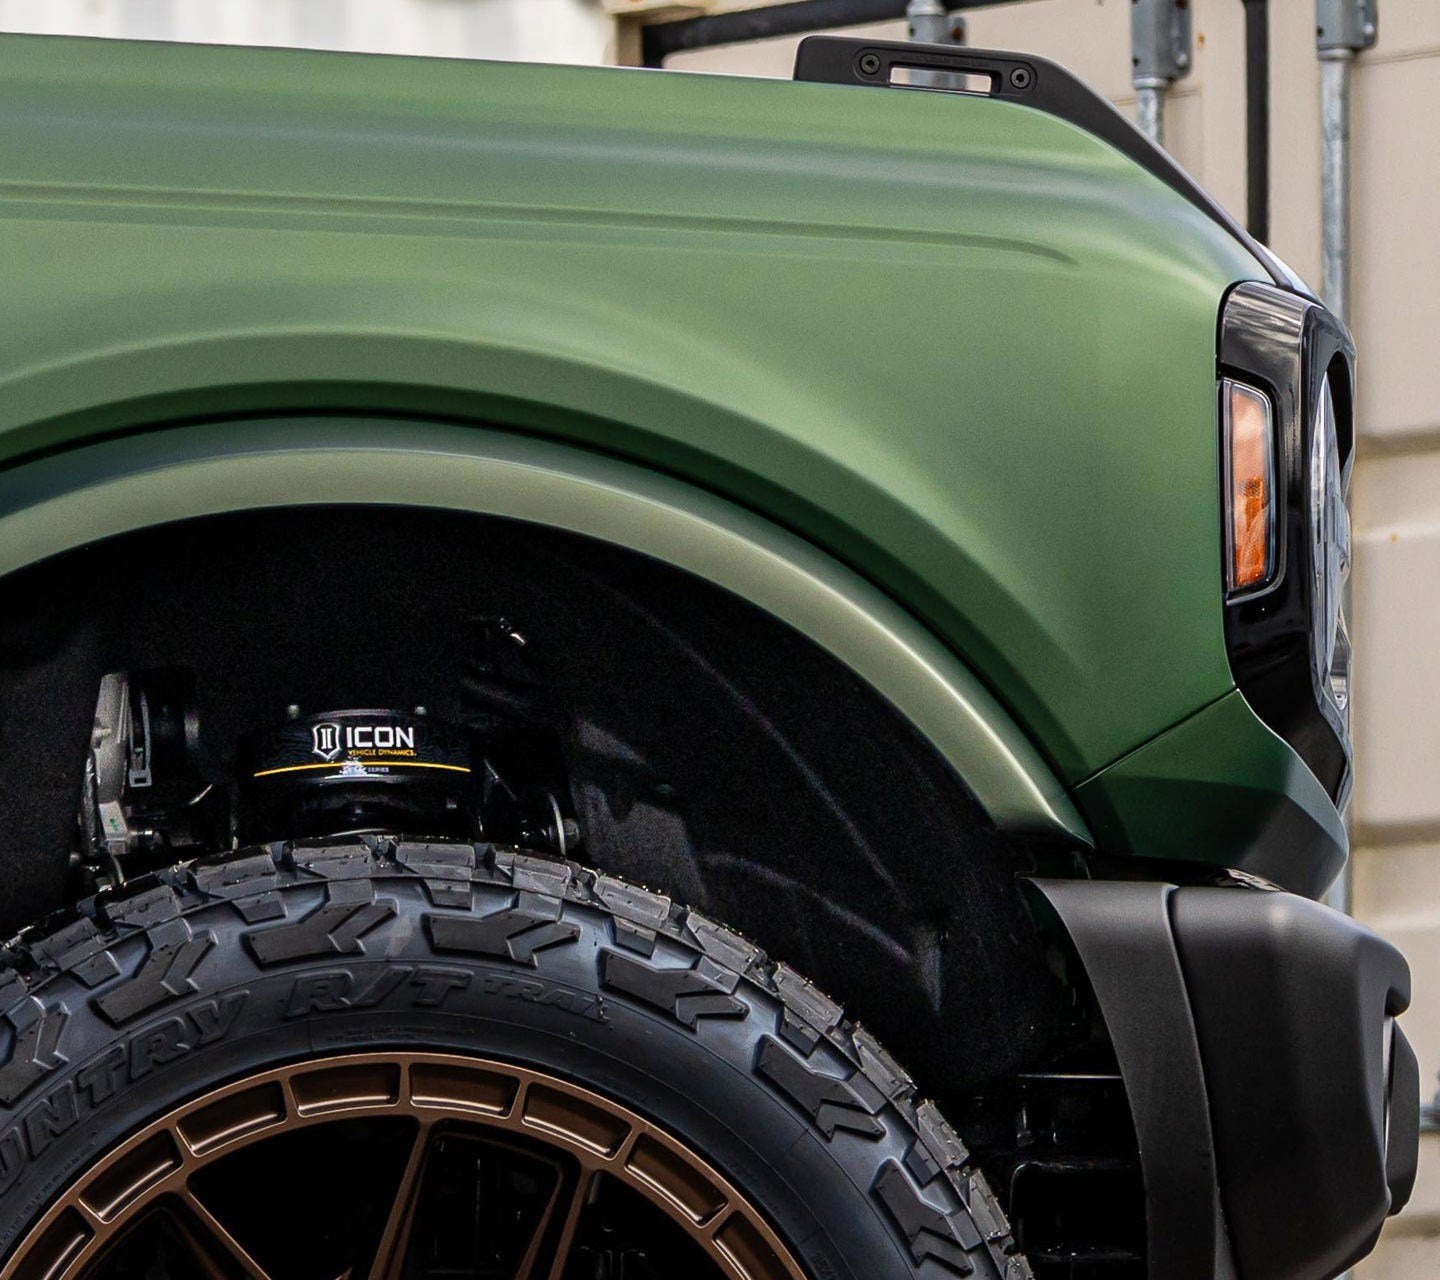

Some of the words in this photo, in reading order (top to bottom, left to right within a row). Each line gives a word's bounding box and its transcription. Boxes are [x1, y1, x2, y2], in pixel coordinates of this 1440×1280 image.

[346, 726, 415, 748] ICON
[284, 963, 475, 1020] R/T
[482, 975, 613, 1026] TRAIL
